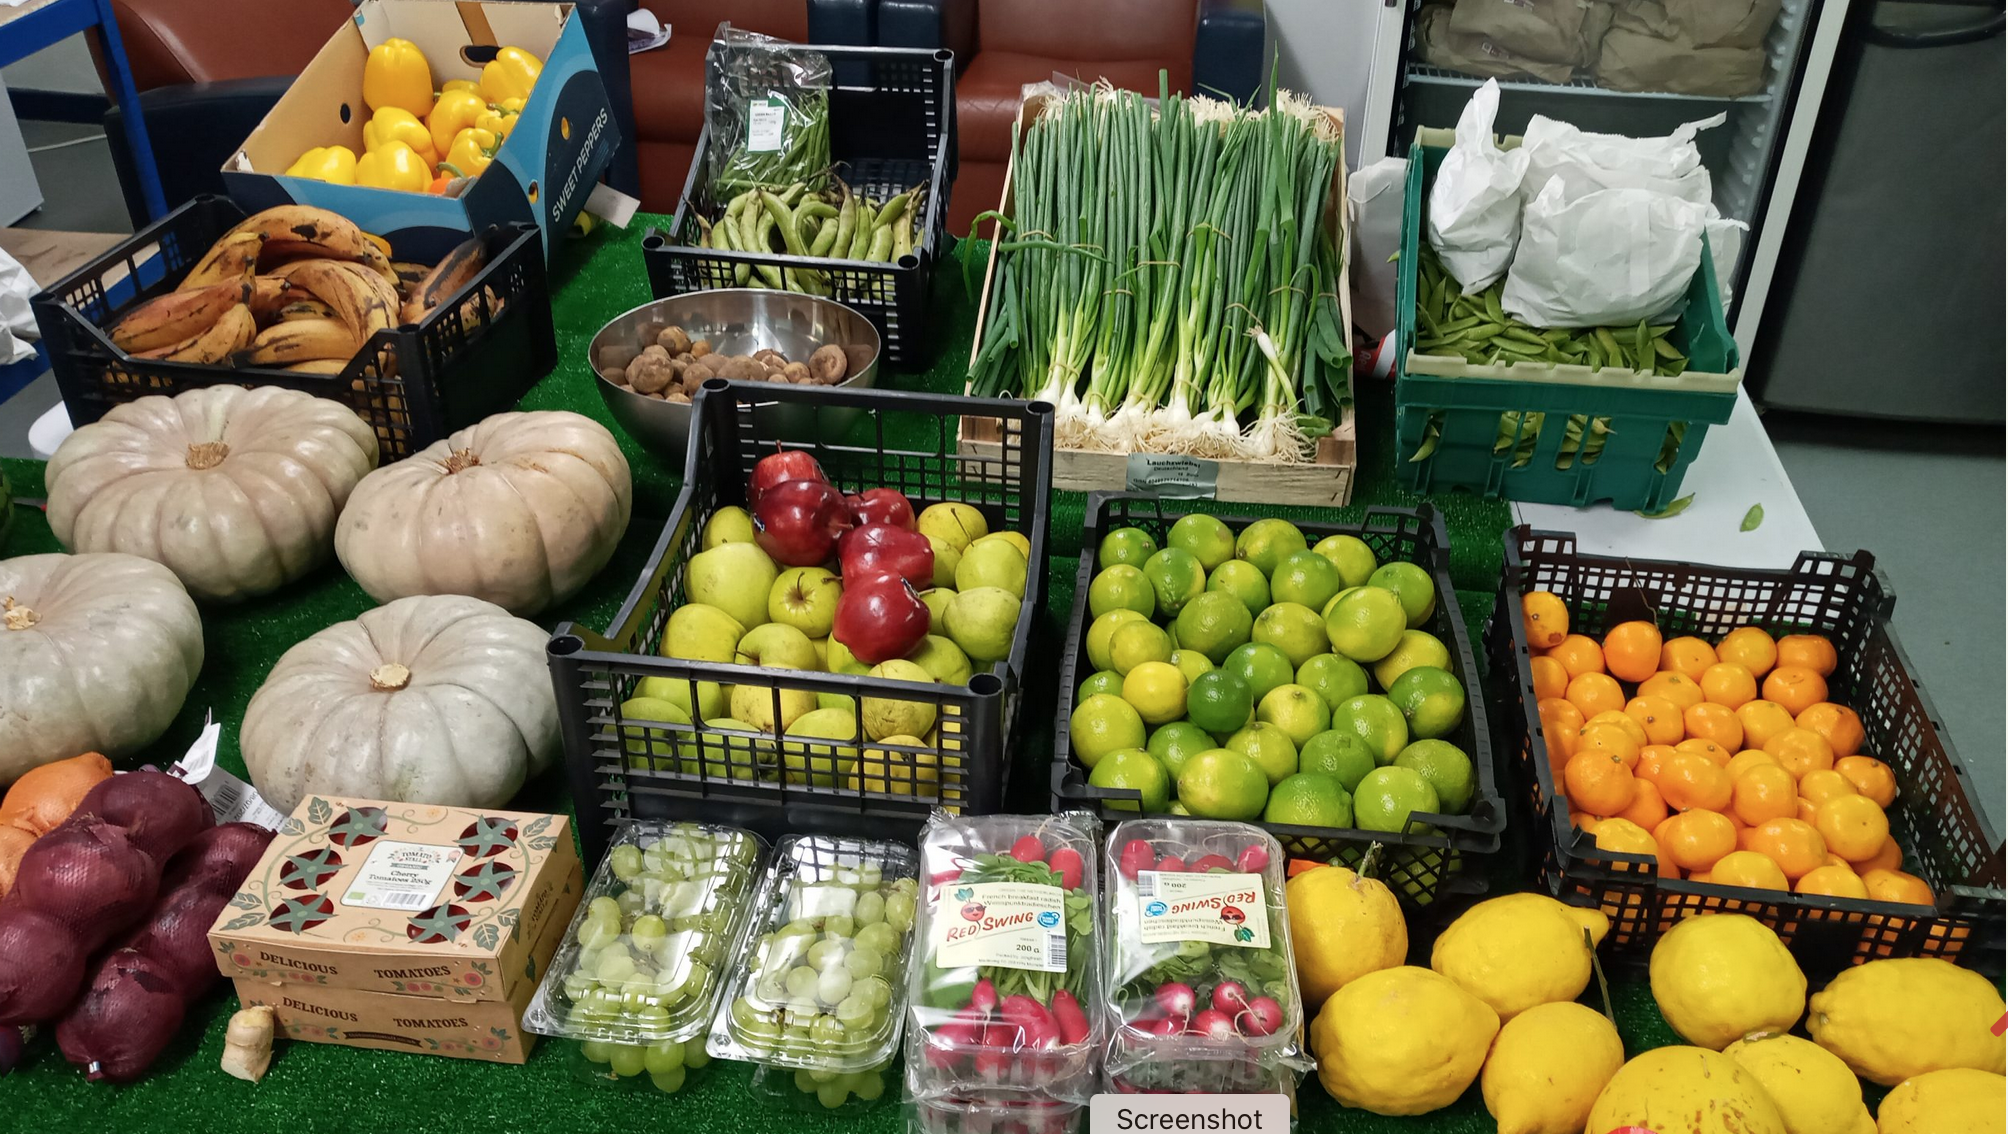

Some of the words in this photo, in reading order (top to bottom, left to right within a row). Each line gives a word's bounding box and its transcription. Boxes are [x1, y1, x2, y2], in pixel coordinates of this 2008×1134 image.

[552, 165, 579, 223] SWEET
[576, 107, 608, 174] PEPPERS
[402, 850, 433, 859] TOMATO
[369, 874, 409, 883] Tomatoes
[390, 870, 419, 878] Cherry
[1007, 894, 1040, 902] breakfast
[1040, 896, 1062, 904] radish
[1227, 891, 1256, 904] RED
[1171, 897, 1222, 914] SWING
[946, 925, 977, 942] RED
[982, 912, 1034, 930] SWING
[1016, 944, 1032, 952] 200
[260, 951, 339, 975] DELICIOUS
[374, 965, 452, 979] TOMATOES
[283, 997, 358, 1022] DELICIOUS
[393, 1017, 469, 1028] TOMATOES
